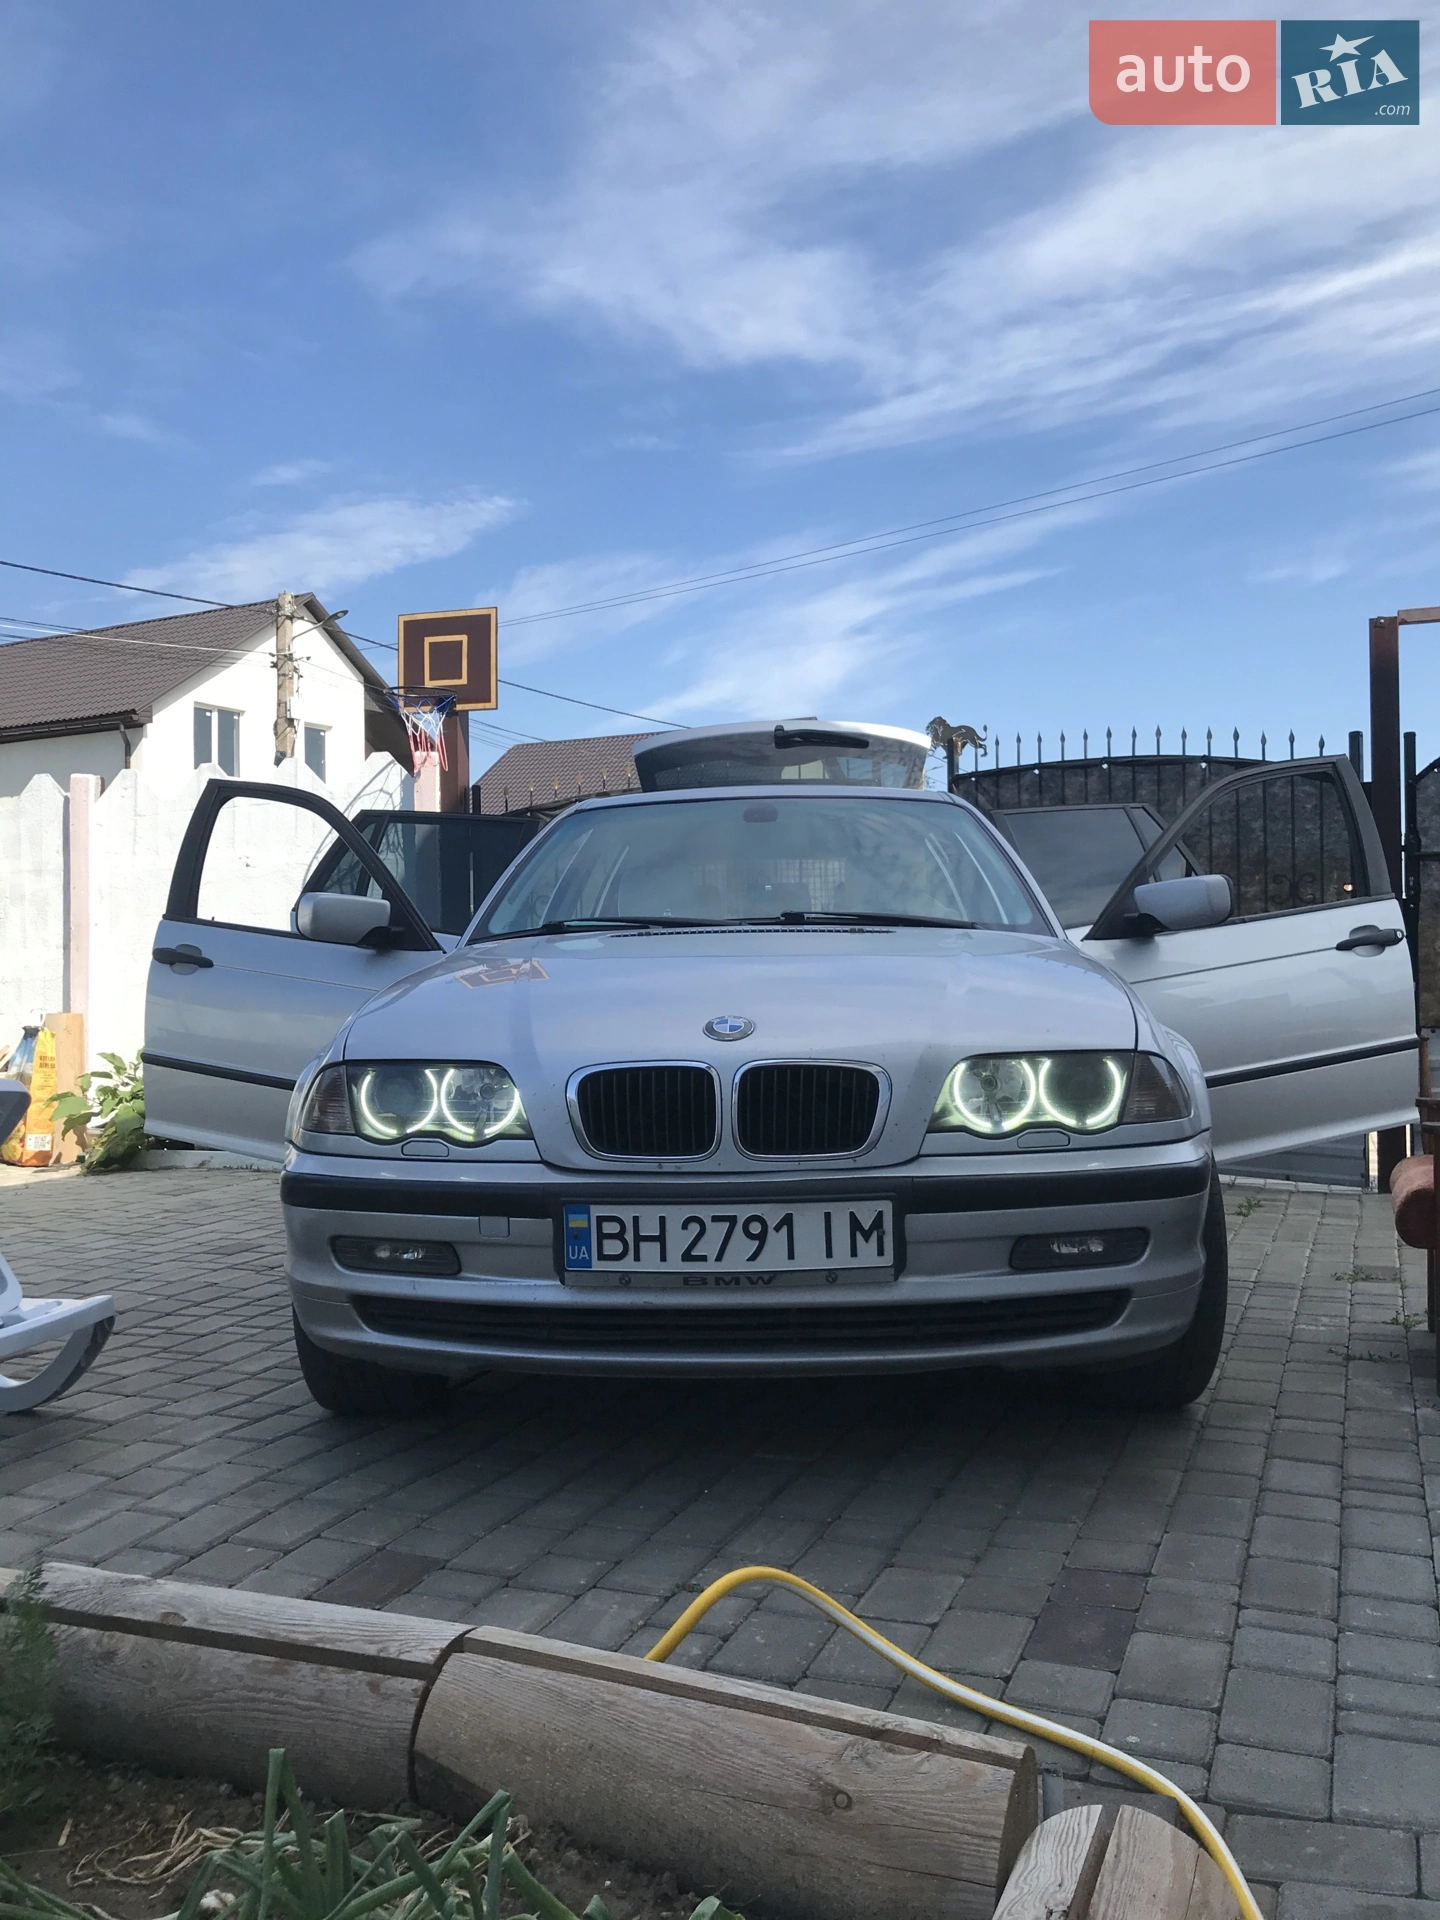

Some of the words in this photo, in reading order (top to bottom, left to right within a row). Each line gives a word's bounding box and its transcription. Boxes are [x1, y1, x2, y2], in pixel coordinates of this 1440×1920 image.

[596, 1214, 667, 1262] BH
[681, 1212, 796, 1262] 2791
[823, 1209, 885, 1259] IM
[568, 1245, 590, 1260] UA
[682, 1273, 778, 1287] BMW
